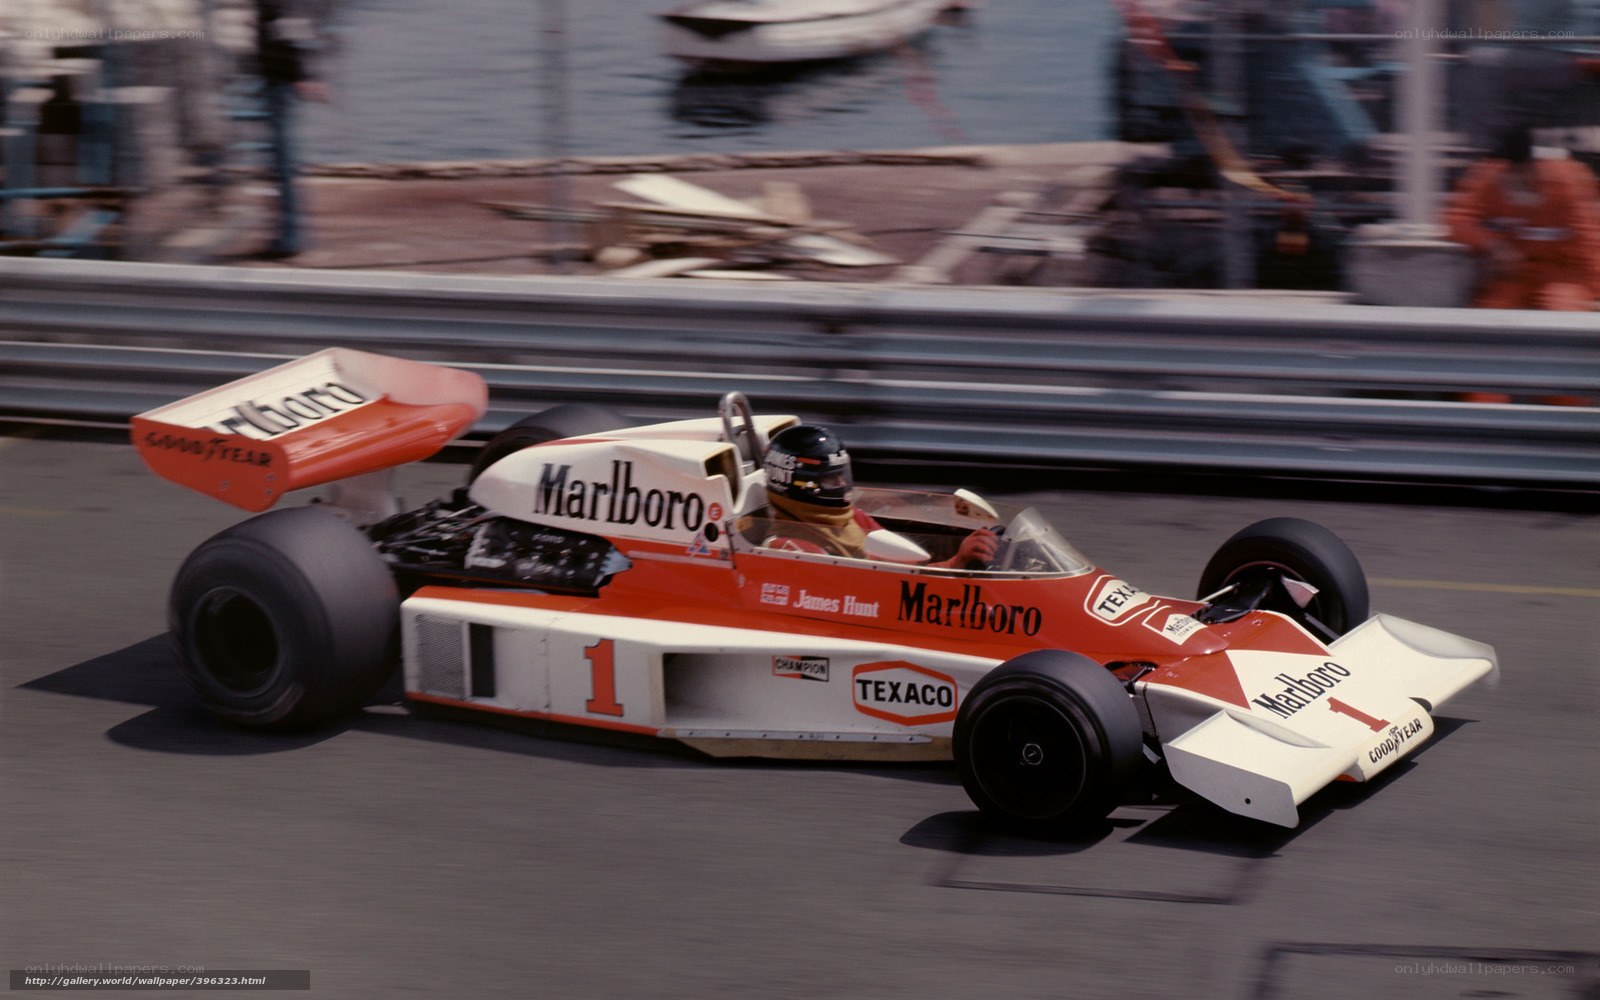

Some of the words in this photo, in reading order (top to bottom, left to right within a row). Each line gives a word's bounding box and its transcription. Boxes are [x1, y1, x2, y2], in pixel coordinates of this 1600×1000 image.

[532, 459, 705, 532] Marlboro
[793, 589, 839, 614] James
[843, 595, 880, 618] Hunt
[897, 579, 1043, 637] Marlboro
[583, 637, 625, 718] 1
[776, 658, 827, 675] CHAMPION
[855, 678, 954, 709] TEXACO
[1252, 661, 1352, 720] Marlboro
[1326, 696, 1391, 734] 1
[1368, 717, 1423, 764] GOODYEAR
